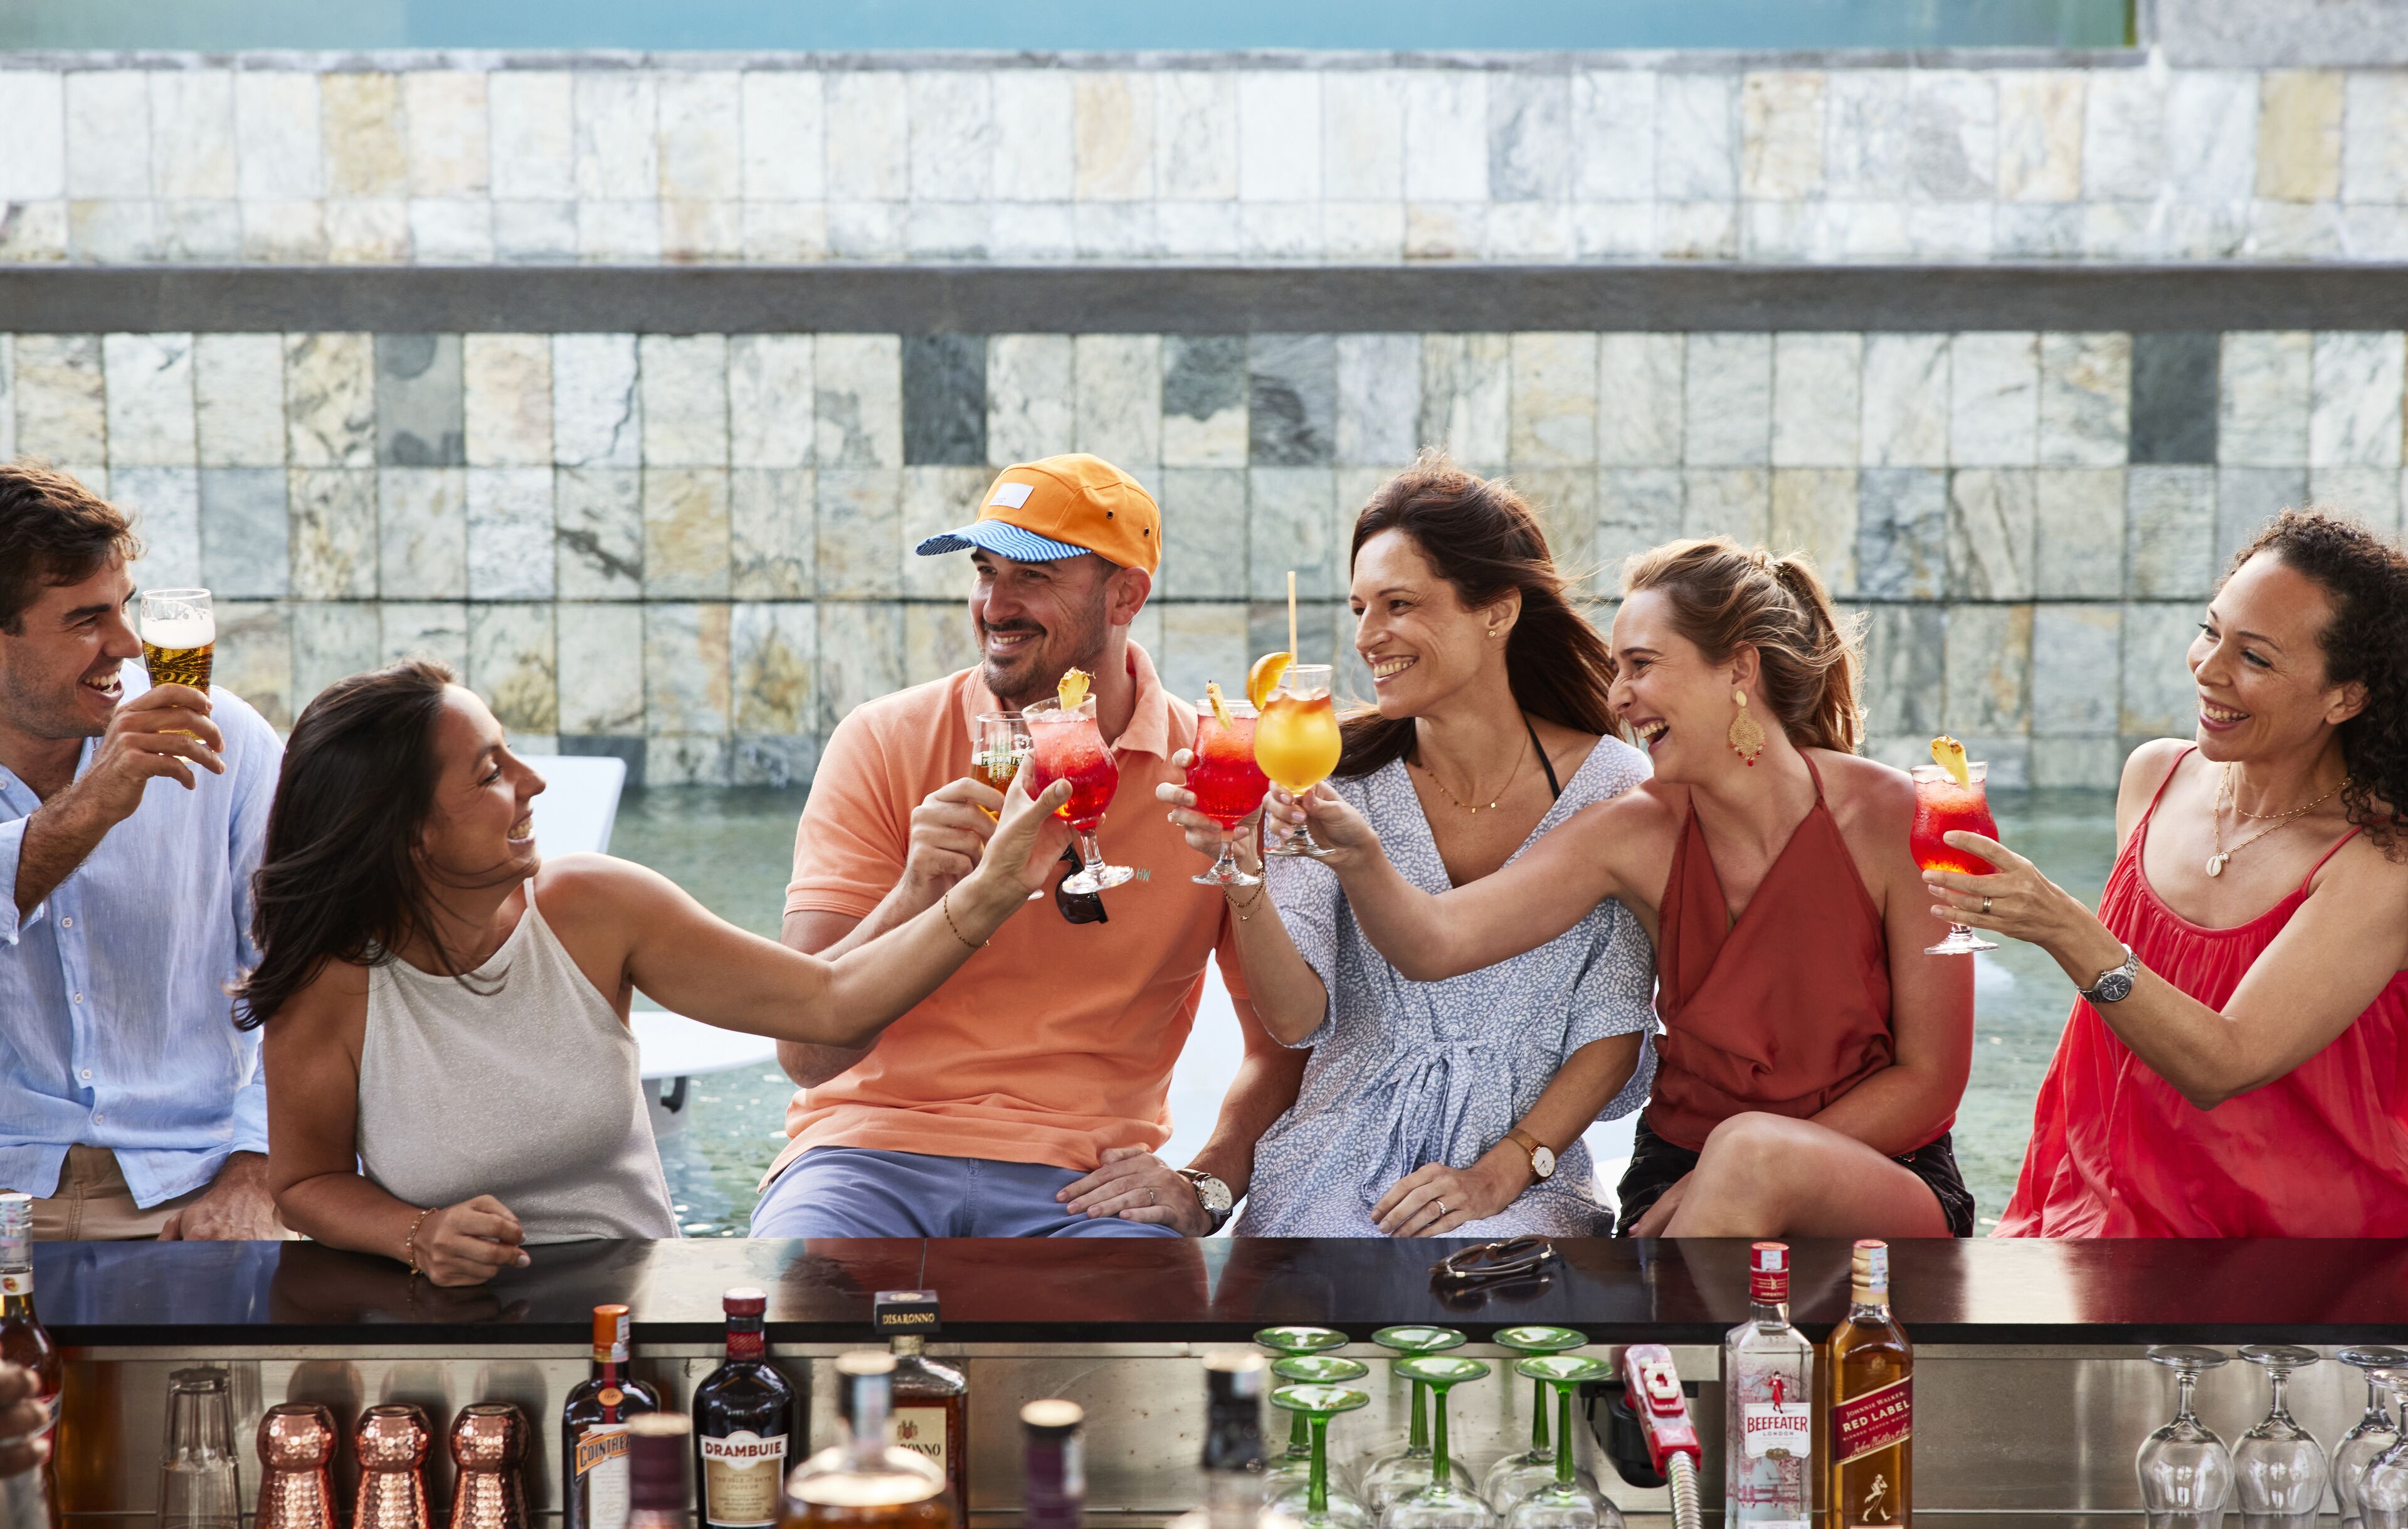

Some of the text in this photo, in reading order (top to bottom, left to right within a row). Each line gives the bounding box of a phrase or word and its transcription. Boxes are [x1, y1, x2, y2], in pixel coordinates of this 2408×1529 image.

[882, 1313, 935, 1325] DISARONNO
[1842, 1400, 1910, 1432] RED LABEL
[1747, 1416, 1809, 1434] BEEFEATER
[704, 1441, 782, 1458] DRAMBUIE
